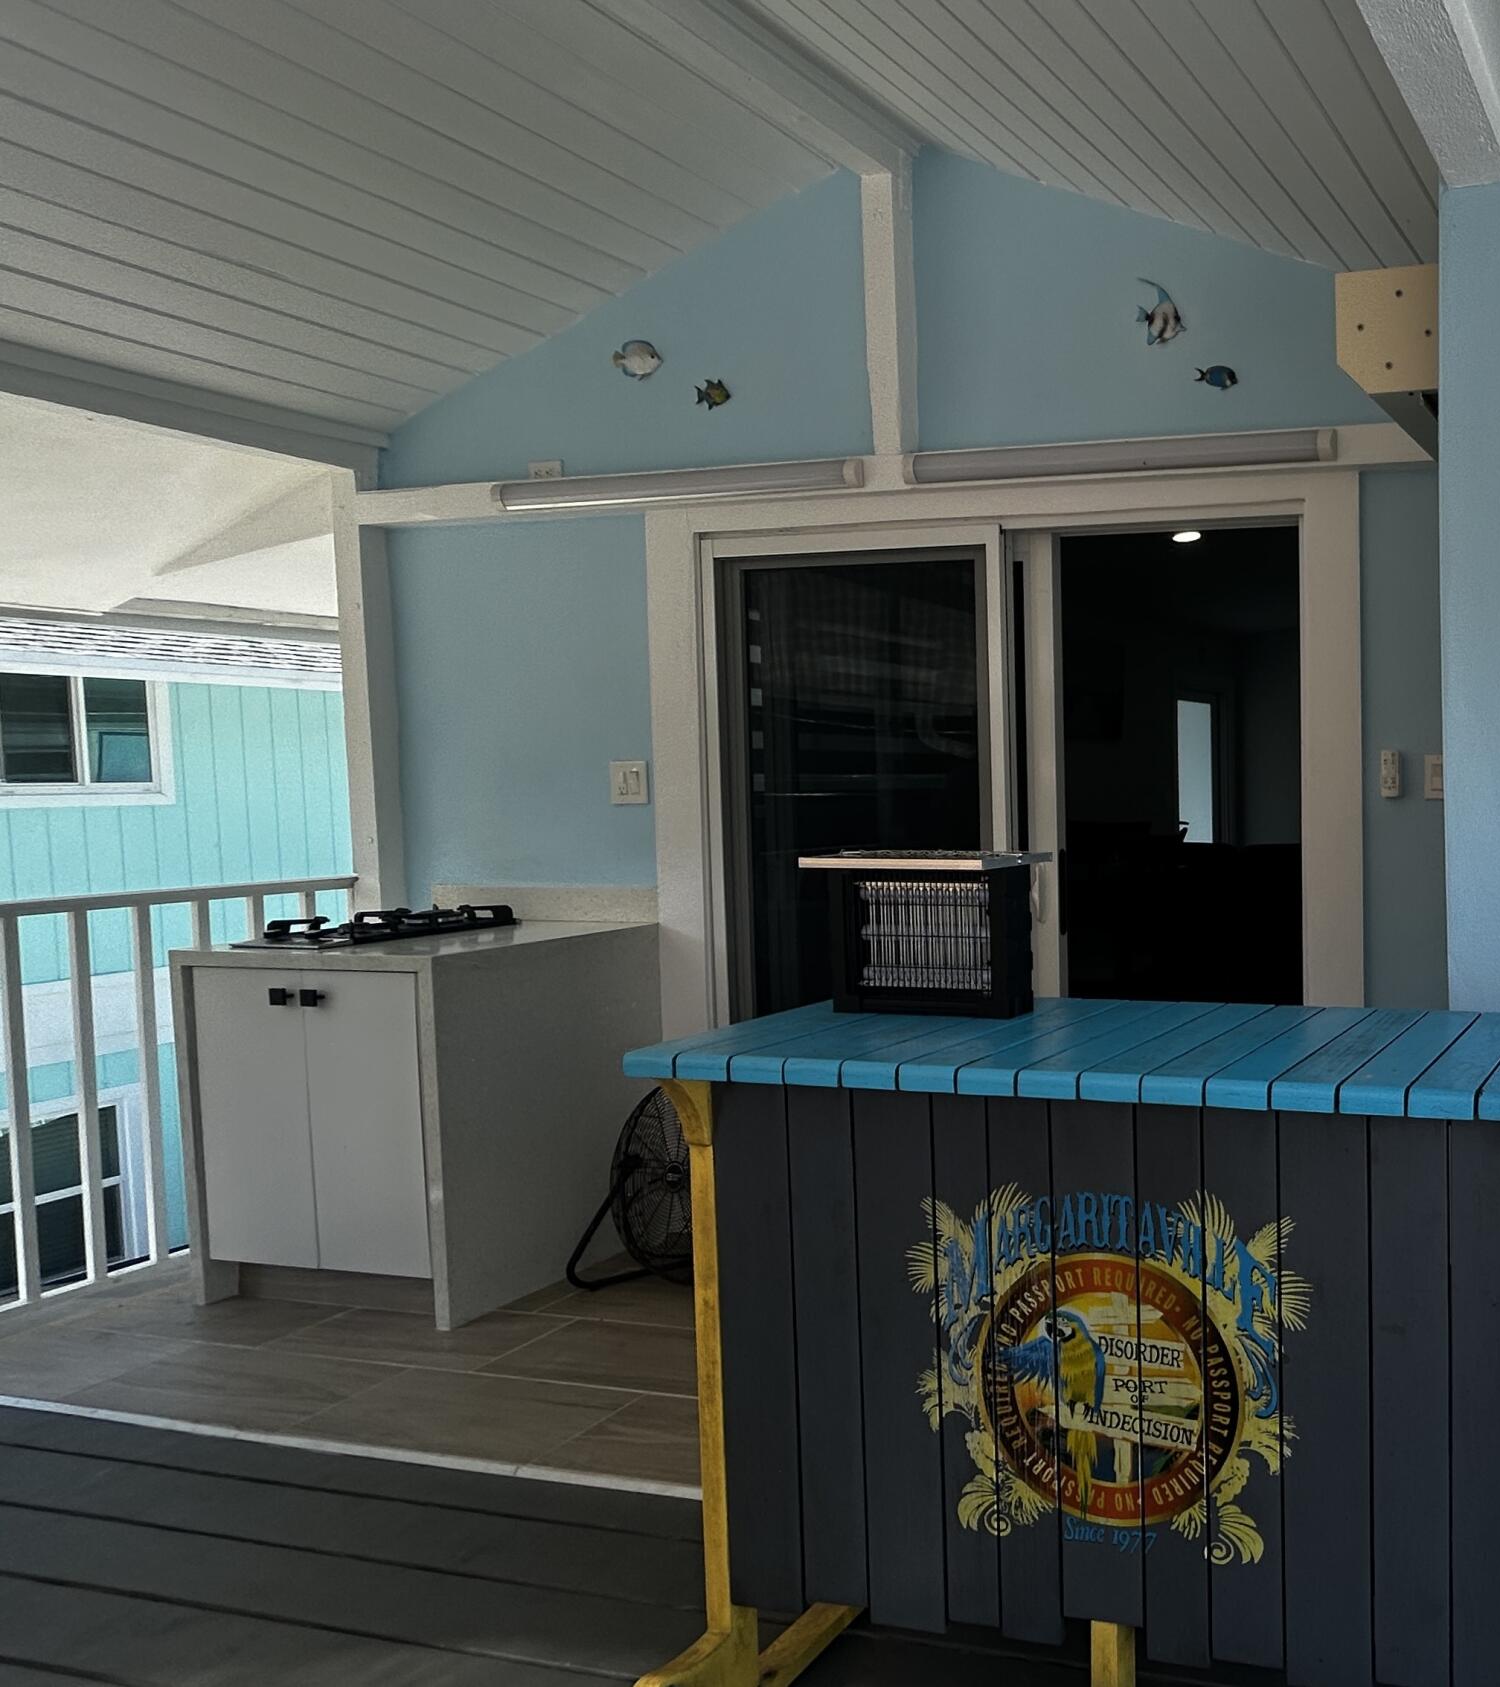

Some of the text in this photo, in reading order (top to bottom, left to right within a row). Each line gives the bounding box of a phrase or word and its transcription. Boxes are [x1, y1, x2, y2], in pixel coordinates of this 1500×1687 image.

[943, 1191, 1279, 1380] MARGARITAVILLE
[996, 1266, 1178, 1347] NO PASSPORT REQUIRED
[1098, 1336, 1182, 1369] DISORDER
[1112, 1377, 1168, 1394] PORT
[1130, 1394, 1149, 1404] OF
[1088, 1408, 1194, 1446] INDECISION
[1151, 1314, 1233, 1506] NO PASSPORT REQUIRED
[1114, 1492, 1135, 1512] NO
[1064, 1516, 1158, 1554] Since 1977
